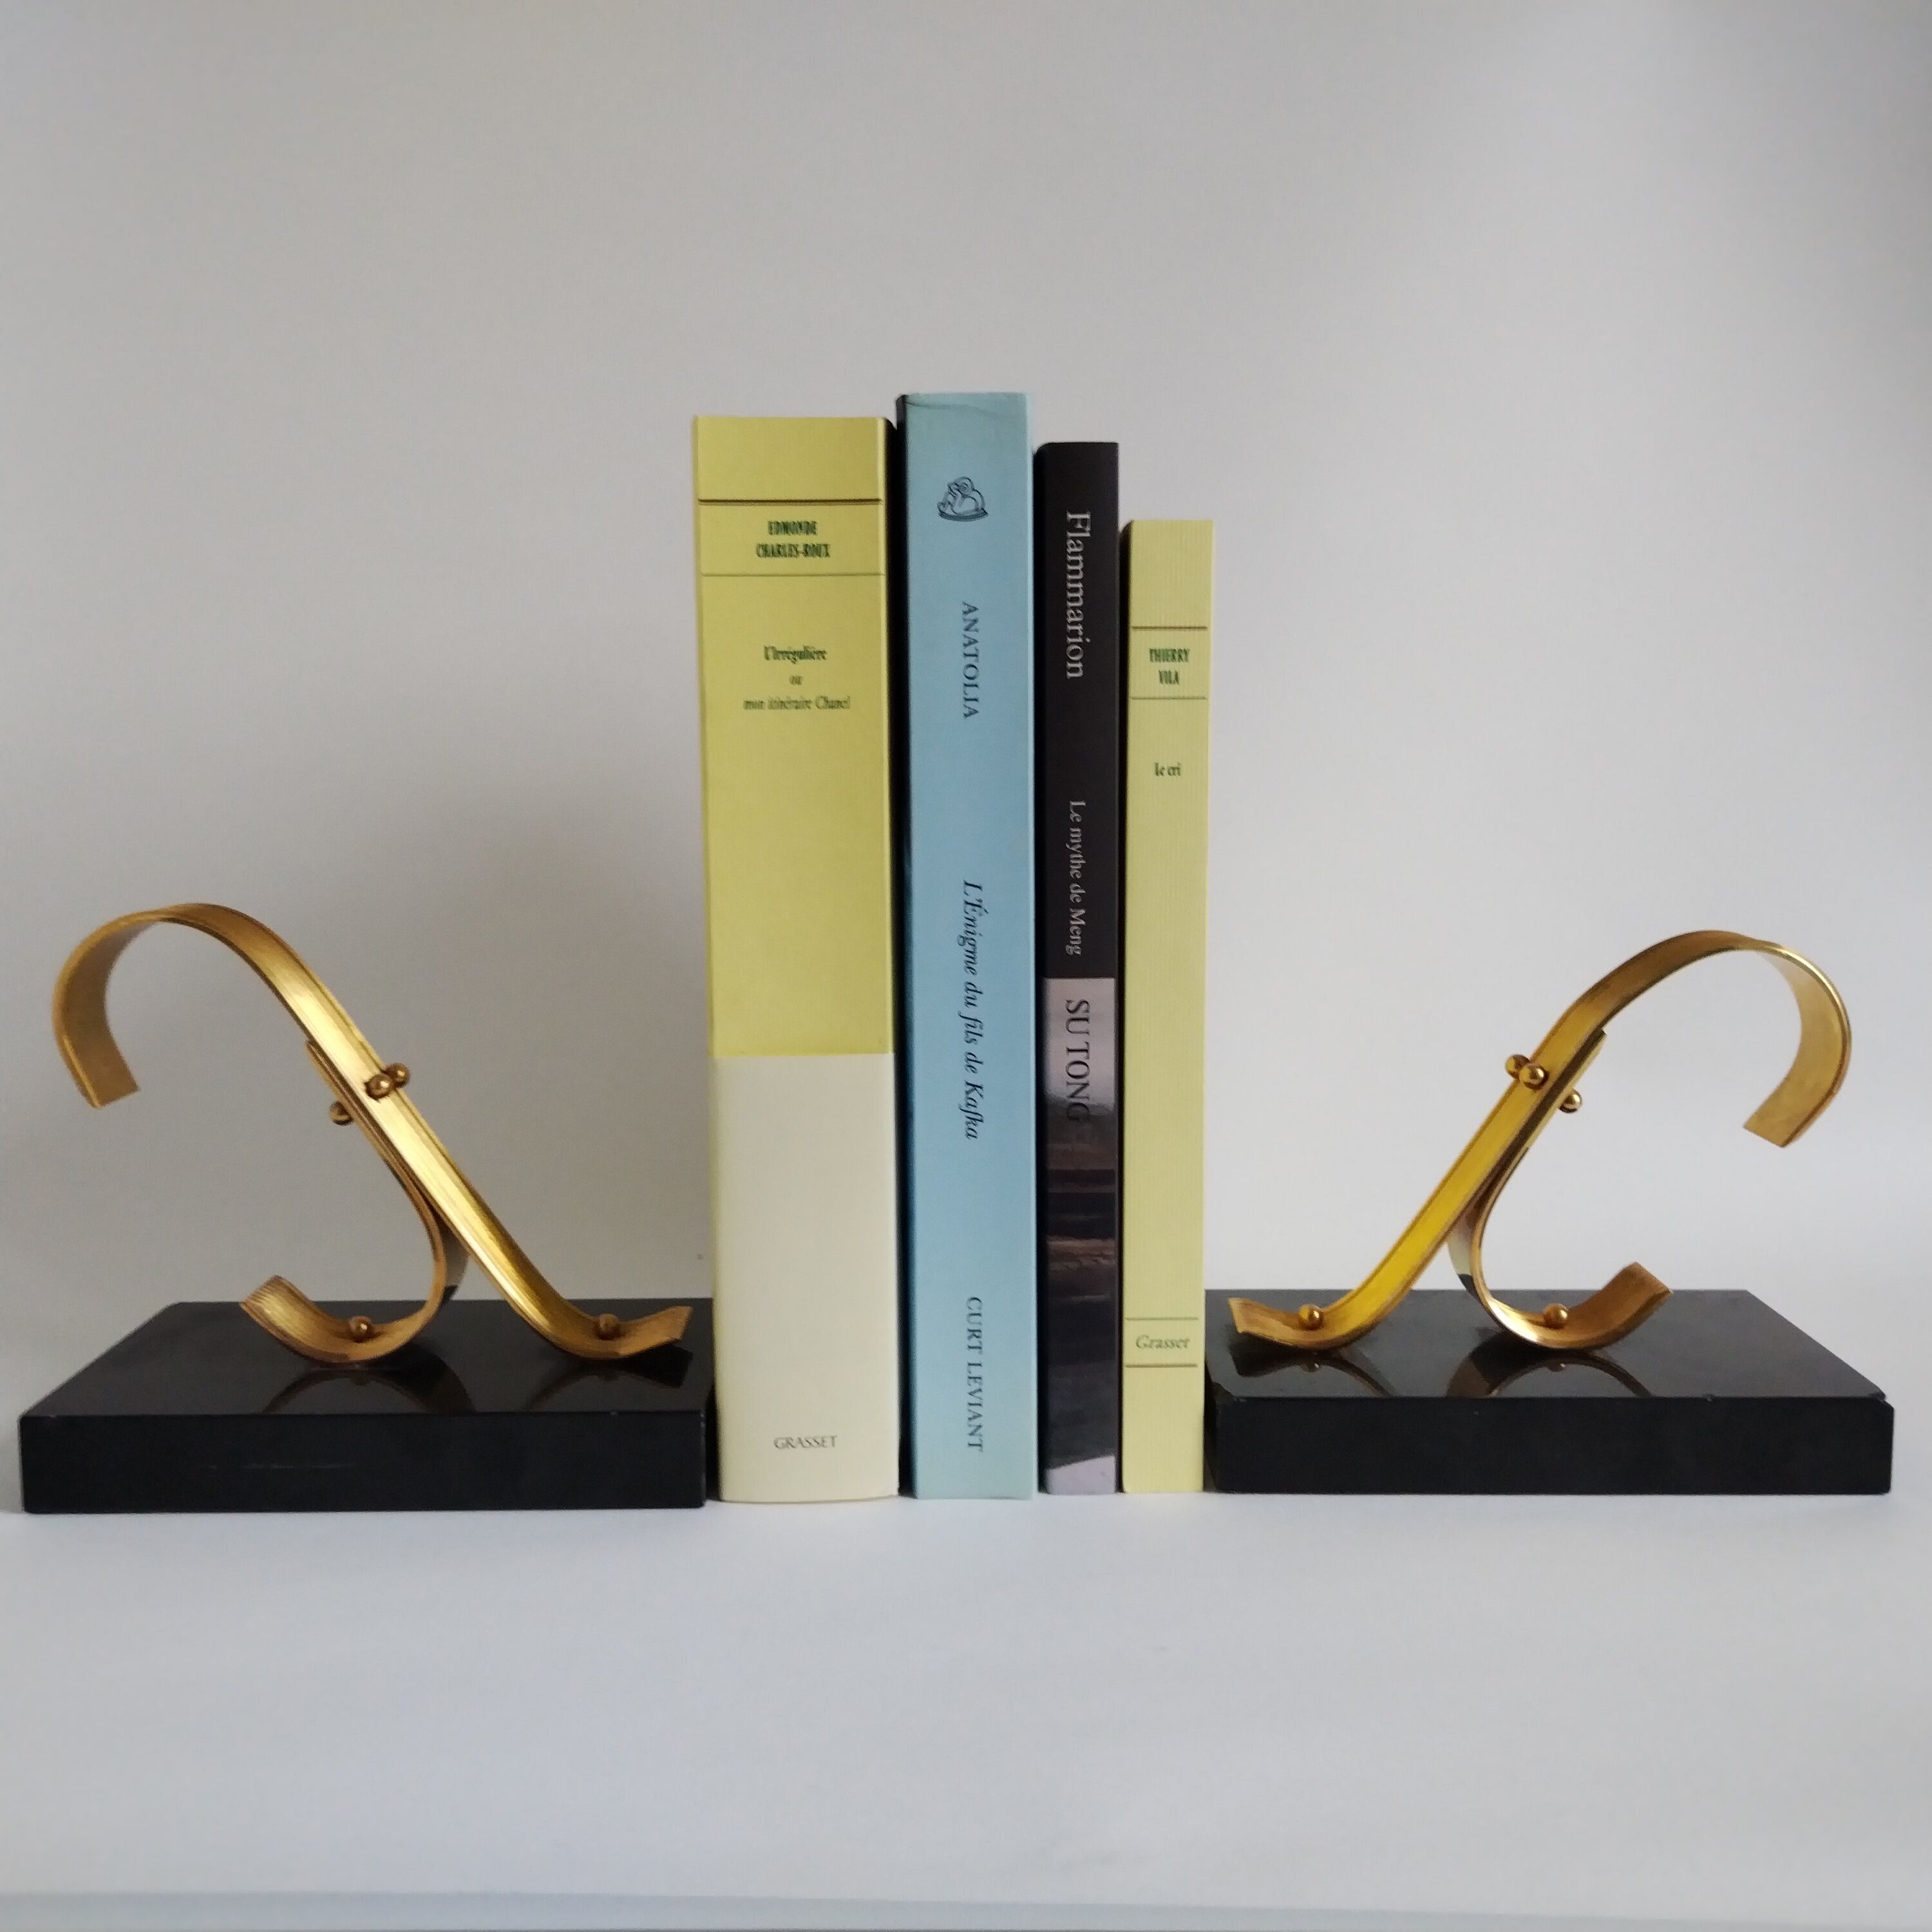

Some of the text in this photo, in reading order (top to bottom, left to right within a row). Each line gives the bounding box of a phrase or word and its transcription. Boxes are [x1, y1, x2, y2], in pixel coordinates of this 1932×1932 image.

[755, 543, 830, 558] CHARLES-ROUX
[768, 520, 817, 536] EDMONDE
[1066, 511, 1091, 679] Flammarion
[962, 601, 980, 719] ANATOLIA
[1149, 649, 1190, 663] THIERRY
[1159, 670, 1179, 685] VILA
[1065, 800, 1086, 956] Le mythe de Meng
[957, 879, 989, 1139] L'Énigme du fils de Kafka
[1065, 999, 1091, 1124] SU TONG
[967, 1296, 983, 1453] CURT LEVIANT
[1135, 1334, 1190, 1350] Grasset
[773, 1435, 837, 1450] GRASSET
